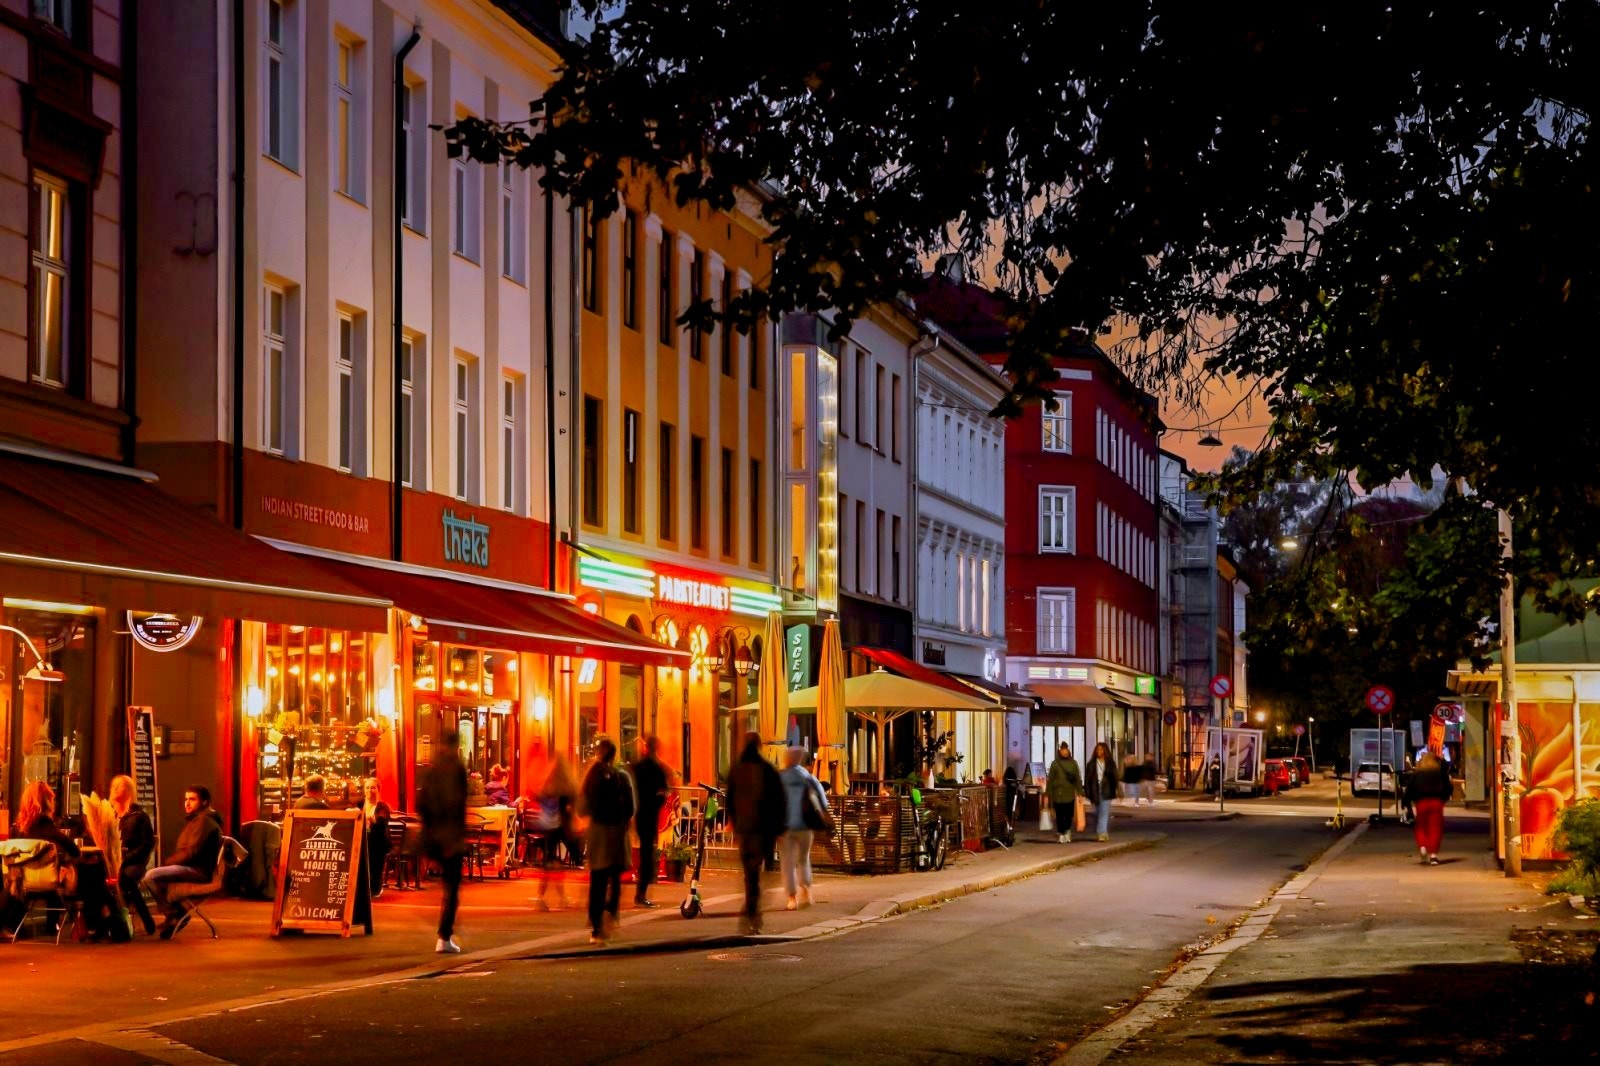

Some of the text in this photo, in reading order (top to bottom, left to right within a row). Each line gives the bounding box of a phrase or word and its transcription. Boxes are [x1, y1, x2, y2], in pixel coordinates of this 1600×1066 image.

[261, 496, 369, 533] INDIAN STREET FOOD & BAR
[442, 508, 489, 567] theka
[1439, 708, 1449, 718] 30
[303, 861, 338, 871] HOURS
